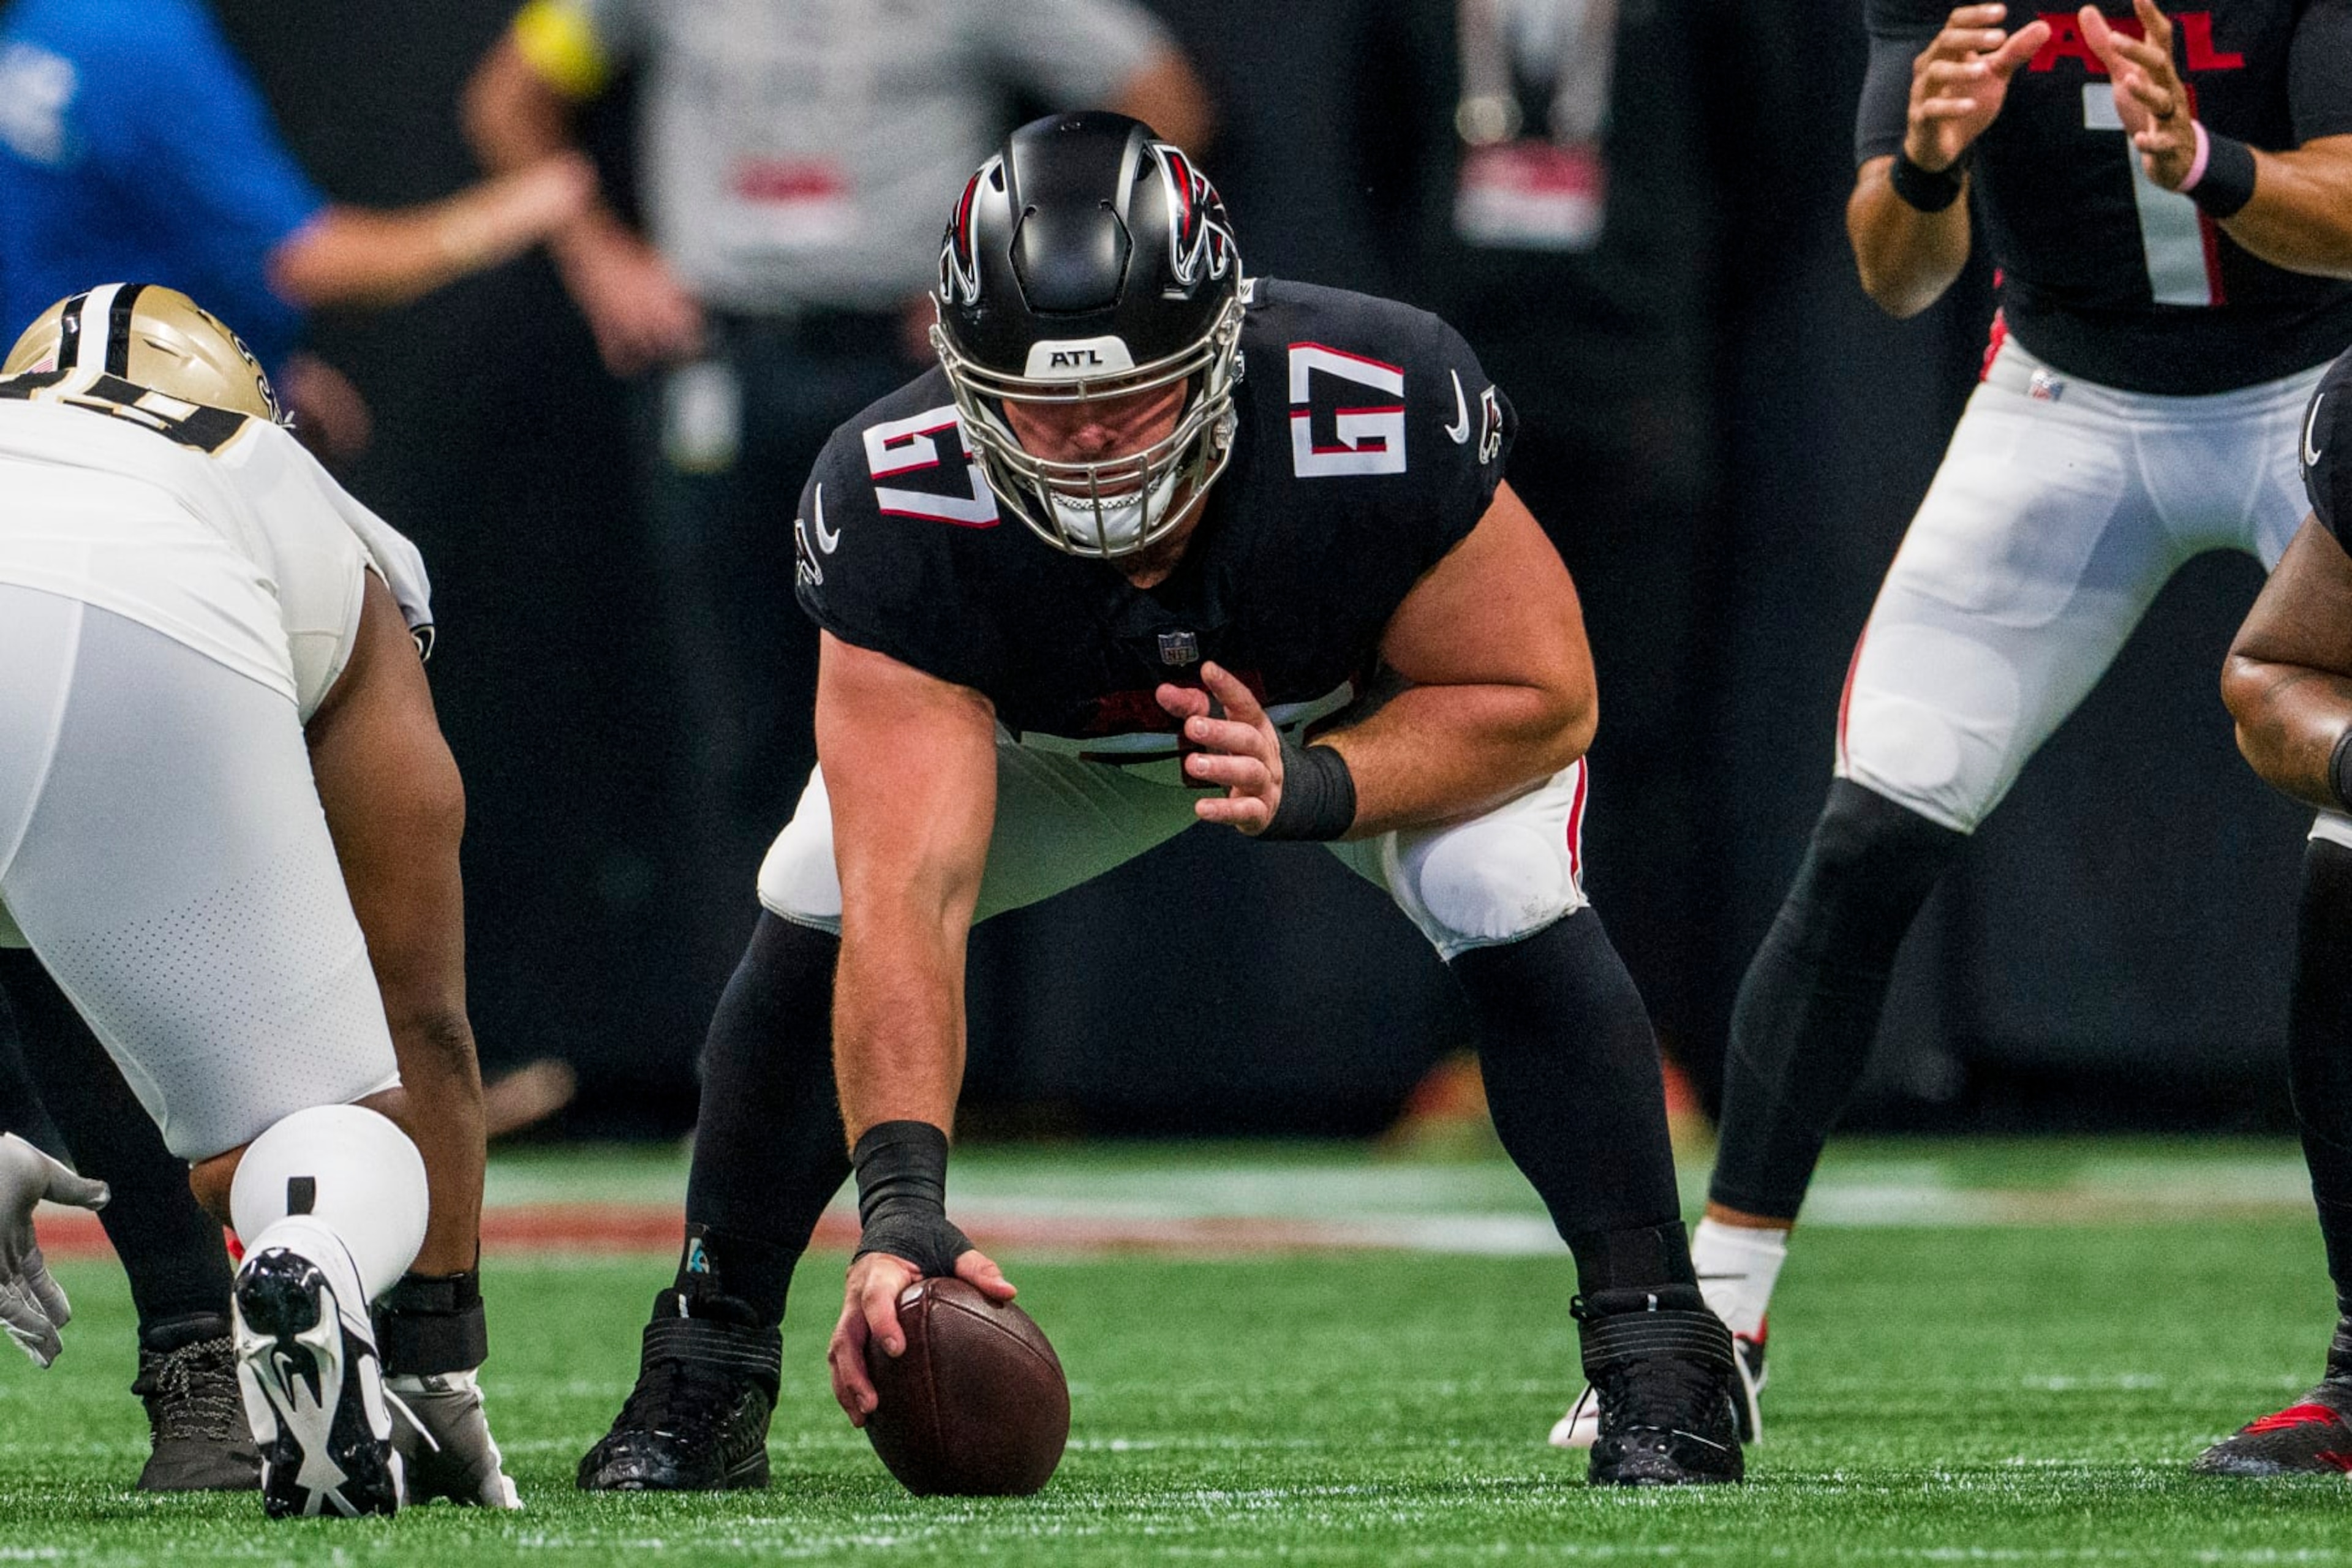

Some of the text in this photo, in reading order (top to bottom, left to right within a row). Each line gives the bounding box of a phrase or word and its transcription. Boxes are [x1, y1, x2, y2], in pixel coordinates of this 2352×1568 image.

[2027, 11, 2246, 73] AL
[2082, 83, 2226, 306] 1
[1051, 350, 1102, 368] ATL
[1288, 341, 1407, 478] 67
[862, 404, 1001, 529] 67
